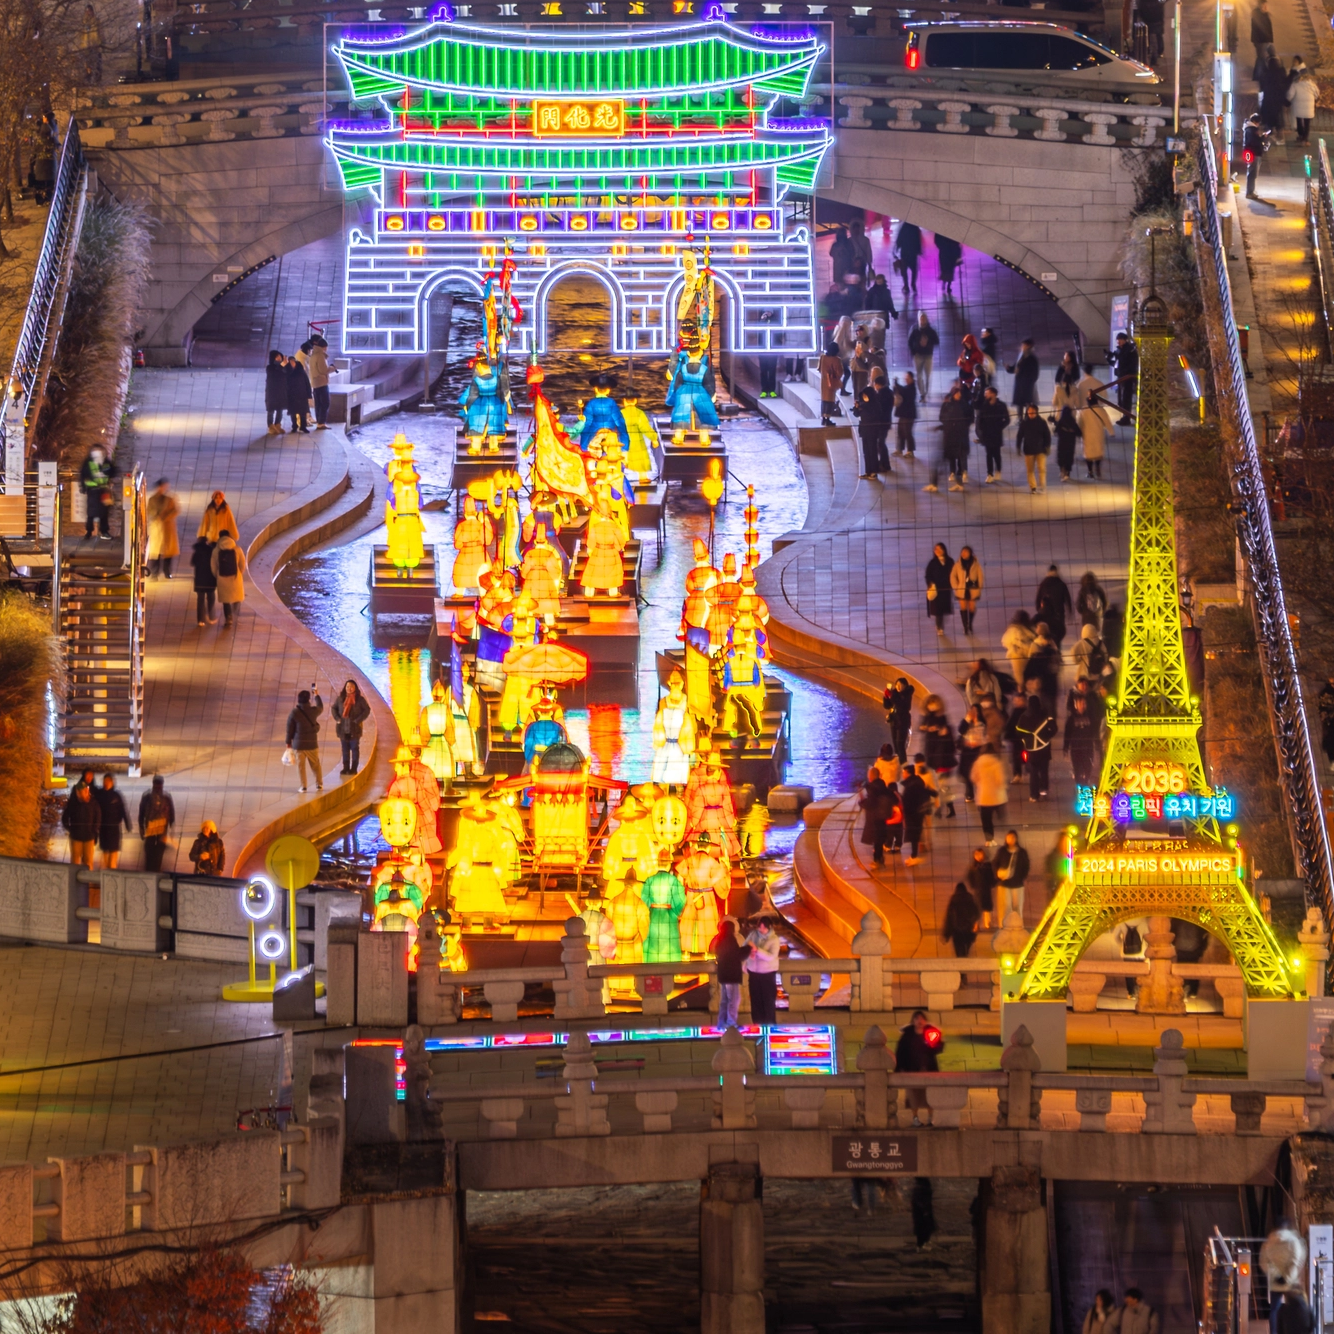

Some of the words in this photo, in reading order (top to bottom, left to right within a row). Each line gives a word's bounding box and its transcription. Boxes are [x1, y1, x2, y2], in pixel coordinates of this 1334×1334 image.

[1125, 771, 1185, 794] 2036
[1078, 798, 1111, 818] 서울
[1115, 798, 1161, 818] 올림픽
[1166, 798, 1197, 818] 유치
[1200, 798, 1234, 818] 기원
[1082, 859, 1115, 873] 2024
[1118, 859, 1158, 873] PARIS
[1162, 859, 1231, 873] OLYMPICS
[848, 1141, 902, 1159] 광통교
[846, 1160, 904, 1171] Gwangtonggyo
